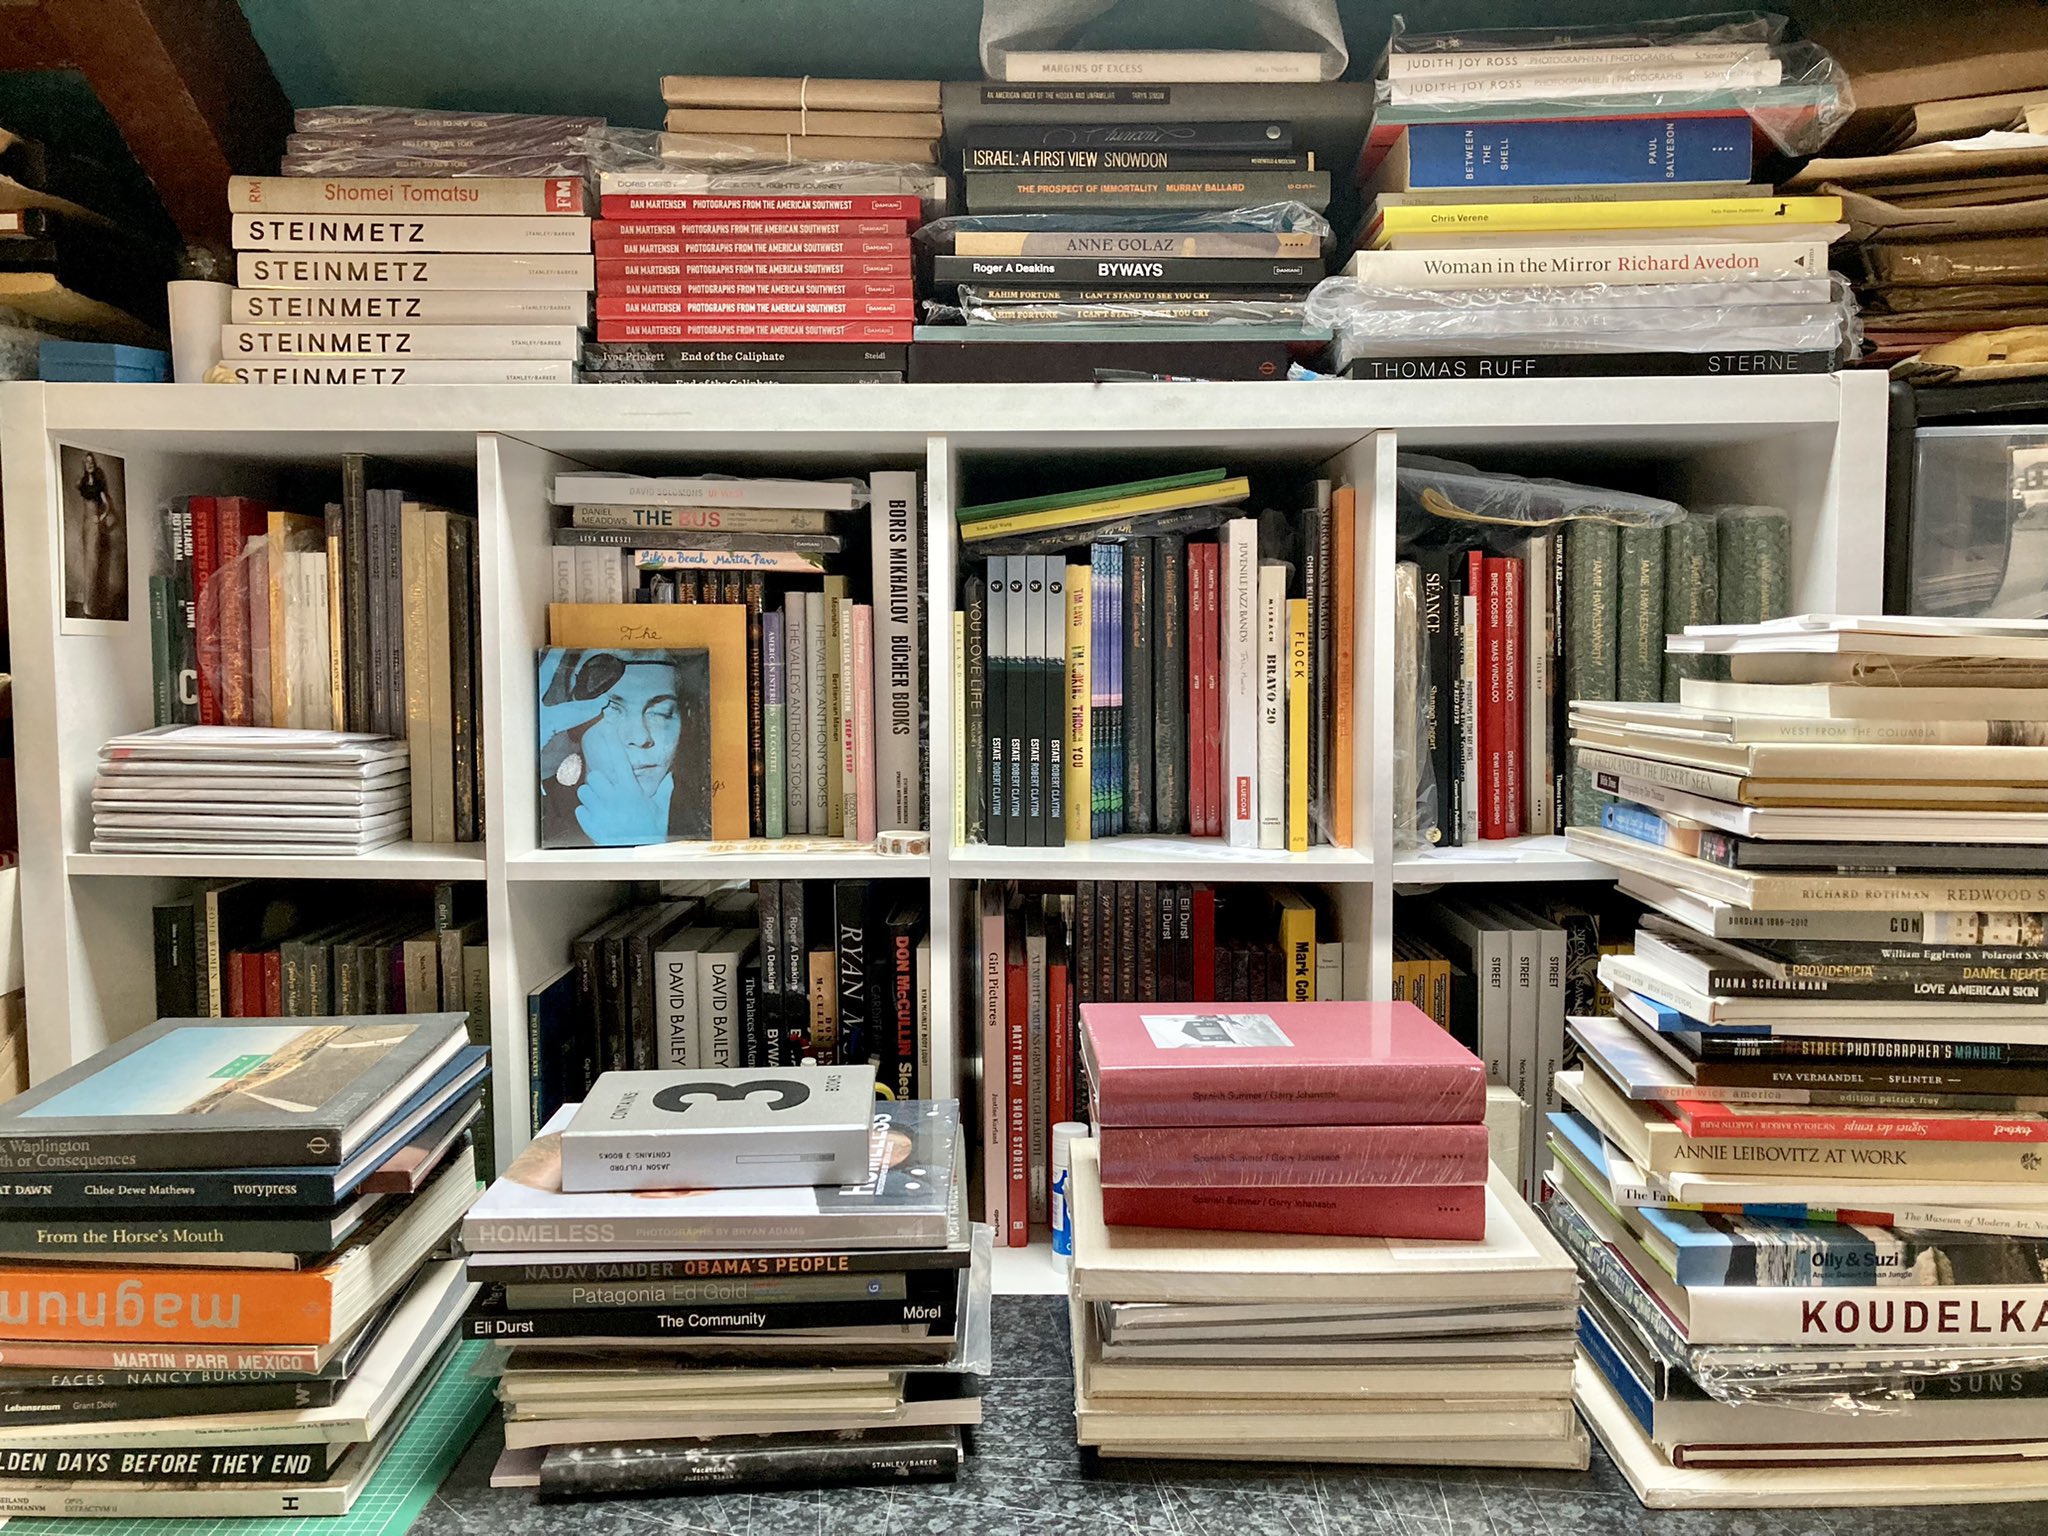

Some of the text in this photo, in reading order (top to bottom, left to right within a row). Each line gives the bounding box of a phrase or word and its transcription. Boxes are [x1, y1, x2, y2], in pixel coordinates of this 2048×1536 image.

[1042, 64, 1143, 73] MARGINS OF EXCESS
[974, 150, 1168, 168] ISRAEL: A FIRST VIEW SNOWDON
[1466, 130, 1474, 180] BETWEEN
[1483, 144, 1492, 165] THE
[1500, 138, 1509, 171] SHELL
[1648, 137, 1657, 164] PAUL
[1666, 122, 1675, 178] SALVESON
[248, 181, 262, 203] RM
[324, 183, 479, 202] Shomei Tomatsu
[555, 180, 572, 208] FM
[1018, 184, 1245, 194] THE PROSPECT OF IMMORTALITY MURRAY BALLARD
[630, 200, 852, 210] DAN MARTENSEN PHOTOGRAPHS FROM THE AMERICAN SOUTHWEST
[1431, 212, 1489, 224] Chris Verene
[250, 222, 424, 243] STEINMETZ
[1066, 238, 1174, 252] ANNE GOLAZ
[973, 262, 1164, 278] Roger A Deakins BYWAYS
[1424, 253, 1760, 275] Woman in the Mirror Richard Avedon
[988, 290, 1018, 299] RAHIM
[1020, 290, 1060, 300] FORTUNE
[1112, 292, 1141, 300] STAND
[1143, 292, 1154, 300] TO
[1156, 292, 1173, 300] SEE
[1174, 292, 1193, 300] YOU
[1194, 292, 1210, 300] CRY
[626, 353, 665, 362] Prickett
[681, 352, 702, 361] End
[703, 352, 714, 361] of
[714, 352, 733, 361] the
[735, 352, 785, 362] Caliphate
[864, 352, 886, 360] Steidl
[1371, 354, 1799, 378] THOMAS RUFF STERNE
[582, 508, 612, 516] DANIEL
[582, 516, 628, 526] MEADOWS
[632, 510, 673, 526] THE
[678, 512, 721, 528] BUS
[640, 551, 778, 566] Life's a Beach Martin Parr
[1426, 572, 1443, 634] SÉANCE
[888, 500, 911, 736] BORIS MIKHAILOV BÜCHER BOOKS
[969, 600, 982, 708] YOU LOVE LIFE
[1295, 632, 1305, 678] FLOCK
[1266, 654, 1277, 724] BRAVO 20
[1780, 726, 1936, 738] WEST FROM THE COLUMBIA
[992, 738, 1002, 816] ESTATE ROBERT CLAYTON
[1802, 889, 2031, 901] RICHARD ROTHMAN REDWOOD
[896, 936, 910, 974] DON
[1296, 941, 1308, 976] Mark
[1881, 949, 2022, 961] William Eggleston Polaroid
[1491, 956, 1500, 988] STREET
[989, 952, 998, 1026] Girl Pictures
[1914, 984, 2039, 997] LOVE AMERICAN SKIN
[669, 962, 686, 1066] DAVID BAILEY
[1802, 1042, 2004, 1060] STREET PHOTOGRAPHER'S MANUAL
[1772, 1072, 1942, 1085] EVA VERMANDEL SPLINTER
[652, 1079, 810, 1113] 3
[1012, 1025, 1023, 1181] MATT HENRY SHORT STORIES
[1840, 1094, 1876, 1104] edition
[1879, 1095, 1916, 1106] patrick
[10, 1140, 90, 1155] Waplington
[1674, 1144, 1907, 1166] ANNIE LEIBOVITZ AT WORK
[17, 1153, 136, 1169] or Consequences
[15, 1185, 52, 1195] DAWN
[84, 1185, 116, 1195] Chloe
[118, 1185, 146, 1196] Dewe
[149, 1185, 196, 1196] Mathews
[37, 1229, 224, 1243] From the Horse's Mouth
[478, 1224, 616, 1244] HOMELESS
[524, 1256, 849, 1280] NADAV KANDER OBAMA'S PEOPLE
[1812, 1252, 1899, 1271] Olly & Suzi
[572, 1282, 747, 1306] Patagonia Ed Gold
[474, 1304, 942, 1334] Eli Durst The Community Mörel
[113, 1352, 303, 1371] MARTIN PARR MEXICO
[5, 1402, 61, 1412] Lebensraum
[56, 1453, 312, 1475] DAYS BEFORE THEY END
